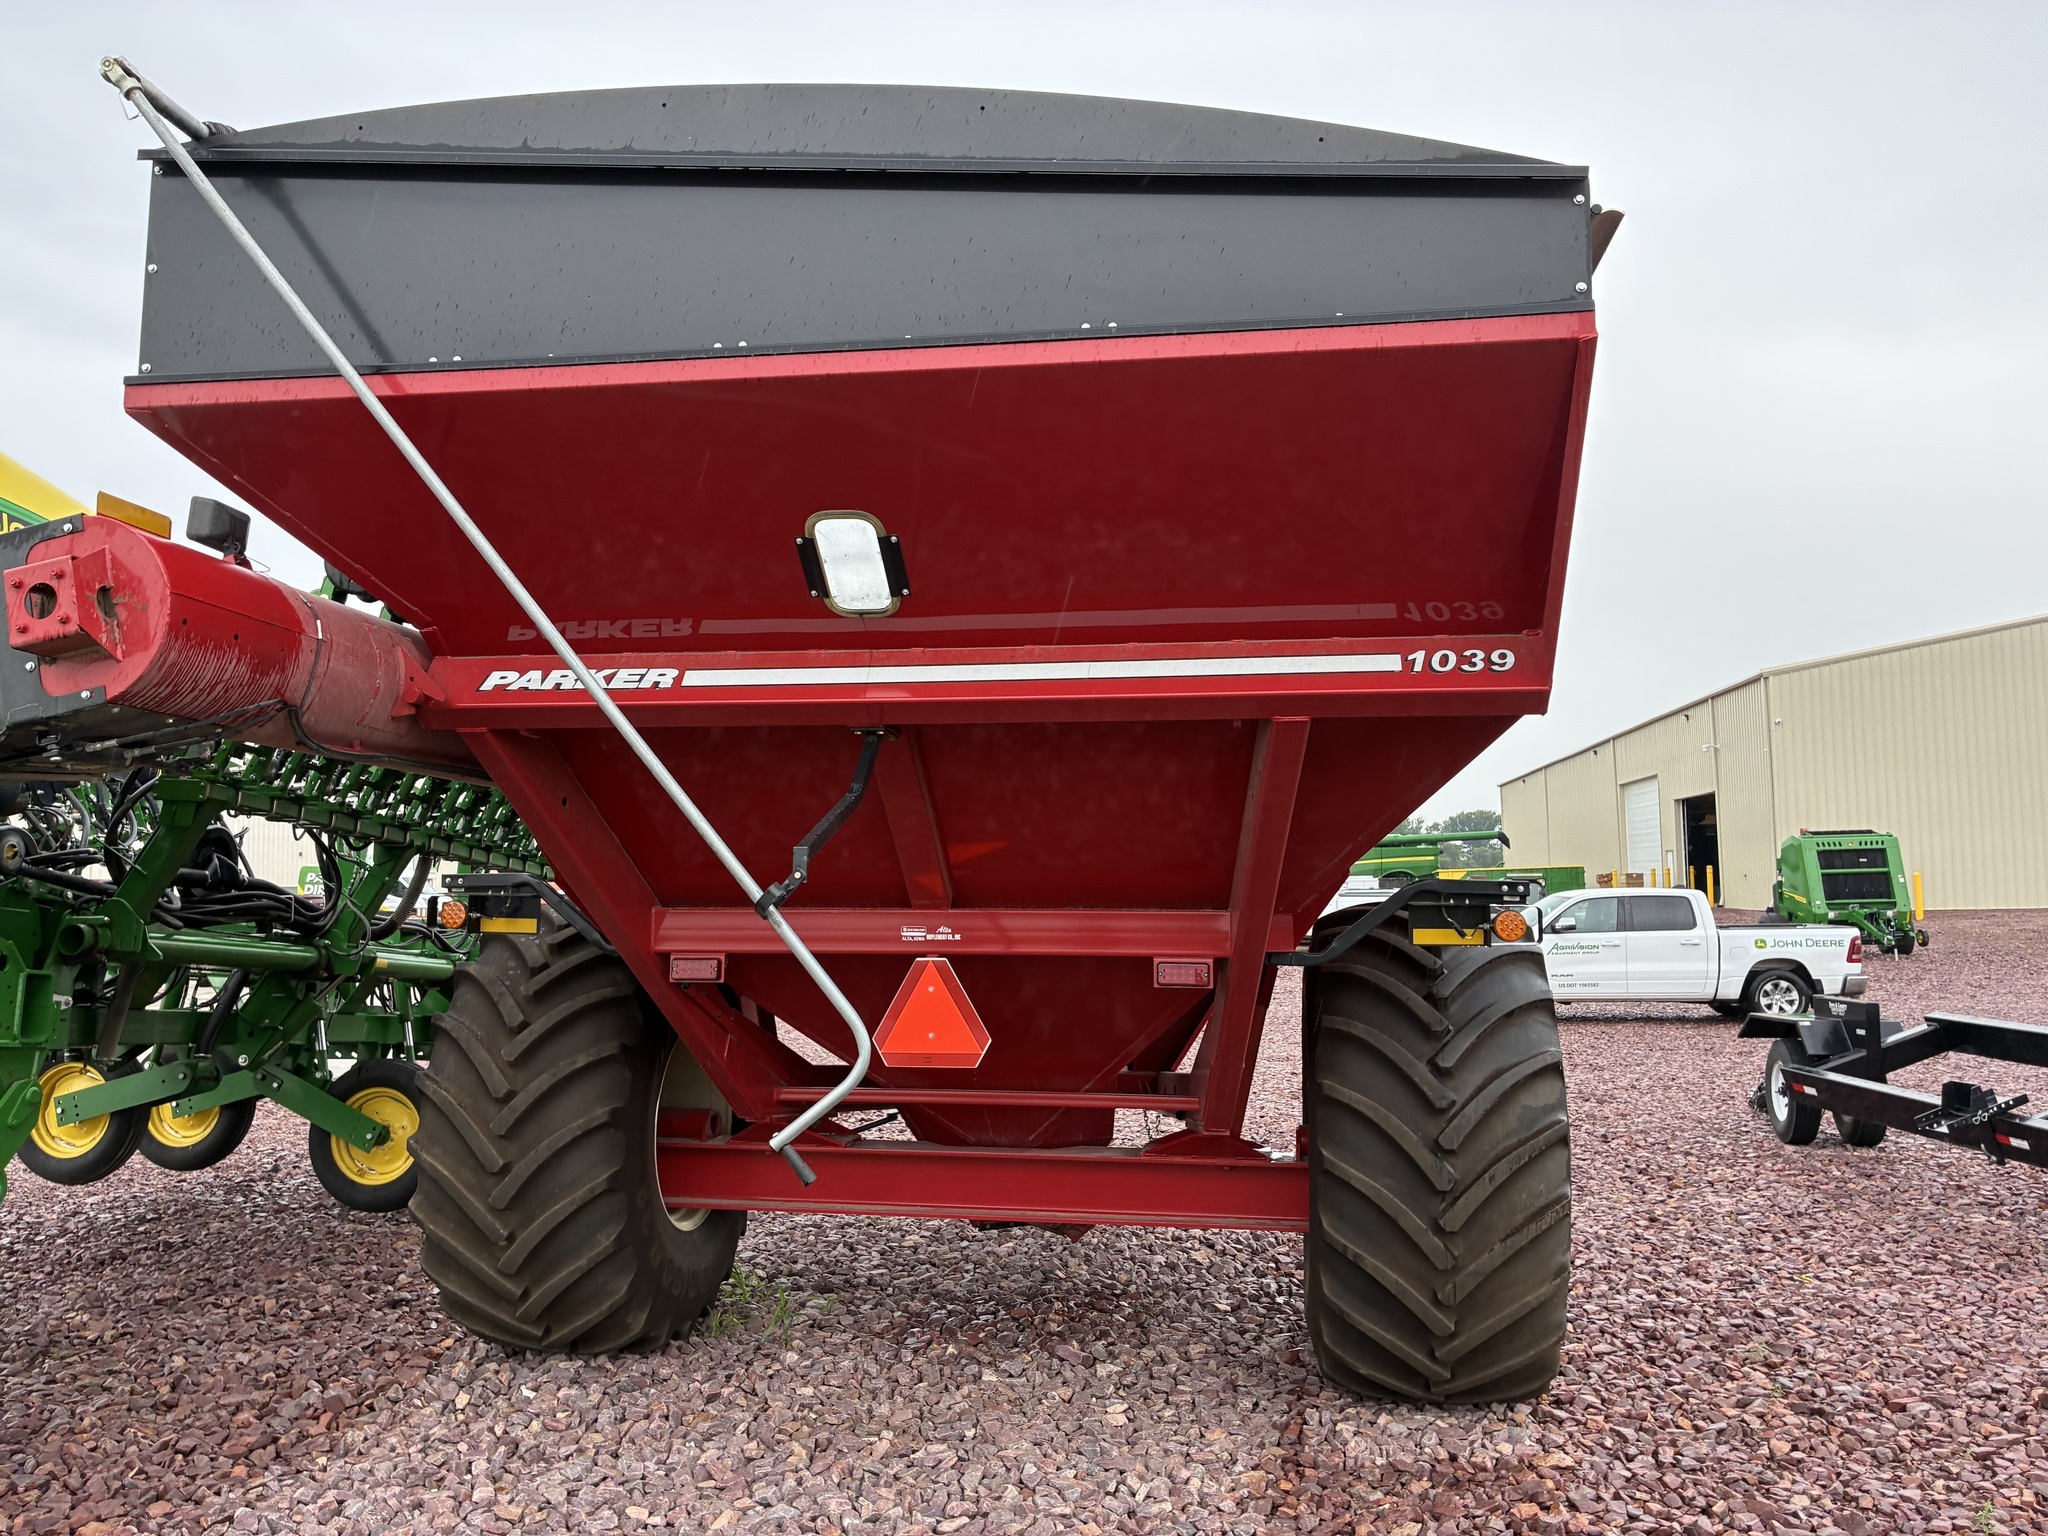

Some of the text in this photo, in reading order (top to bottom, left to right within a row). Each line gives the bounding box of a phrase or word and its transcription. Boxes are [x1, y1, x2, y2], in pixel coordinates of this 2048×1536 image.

[1404, 649, 1516, 674] 1039
[1770, 939, 1845, 948] JOHN DEERE
